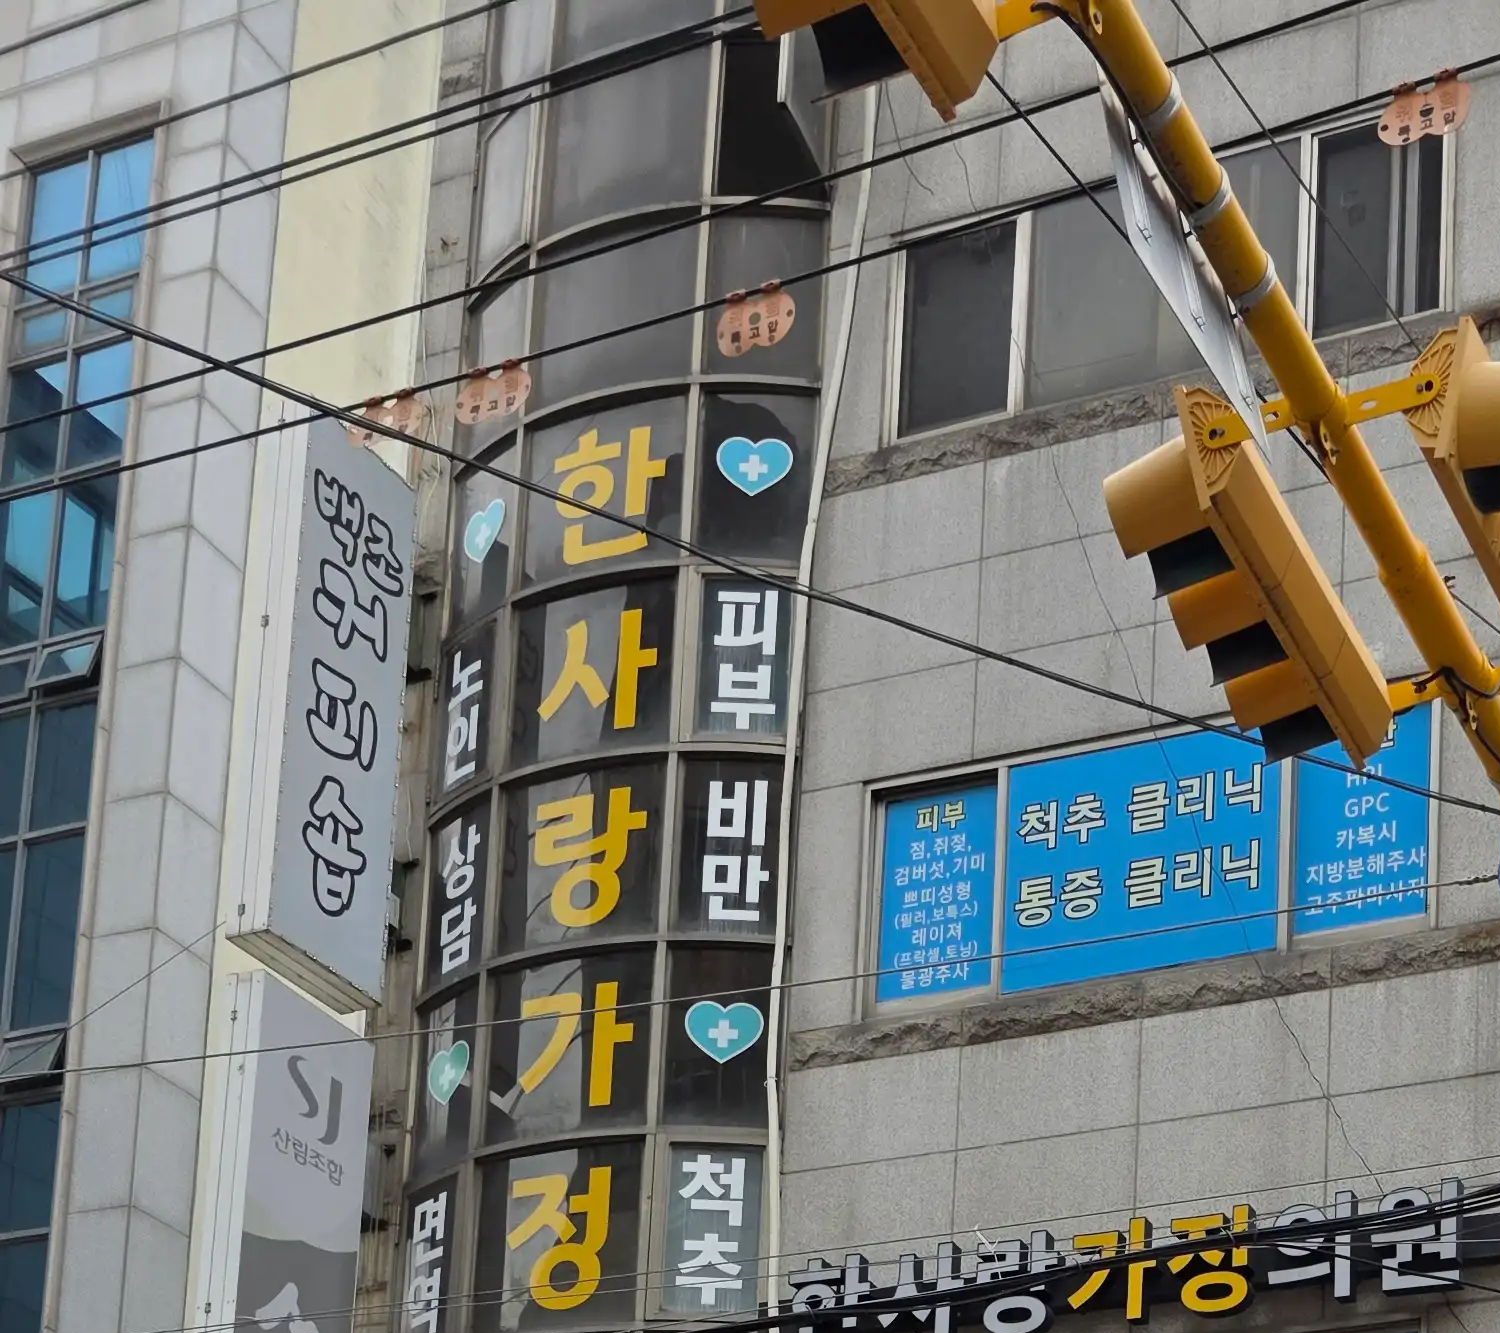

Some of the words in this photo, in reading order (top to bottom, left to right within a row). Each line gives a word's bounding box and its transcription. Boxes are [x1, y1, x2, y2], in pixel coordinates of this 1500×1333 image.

[711, 589, 778, 731] 피부
[445, 650, 484, 788] 노인
[916, 800, 965, 833] 피부
[1017, 792, 1108, 851] 척추
[1125, 761, 1265, 836] 클리닉
[1335, 820, 1397, 850] 카복시
[1344, 792, 1390, 818] GPC
[701, 780, 770, 923] 비만
[1305, 845, 1427, 886] 지방분해주사
[440, 820, 481, 977] 상담
[902, 881, 971, 908] 쁘띠성형
[1013, 870, 1104, 929] 통증
[1125, 838, 1262, 910] 클리닉
[911, 921, 962, 947] 레이져
[900, 963, 970, 990] 물광주사
[270, 1125, 345, 1188] 산림조합
[676, 1153, 747, 1306] 척추
